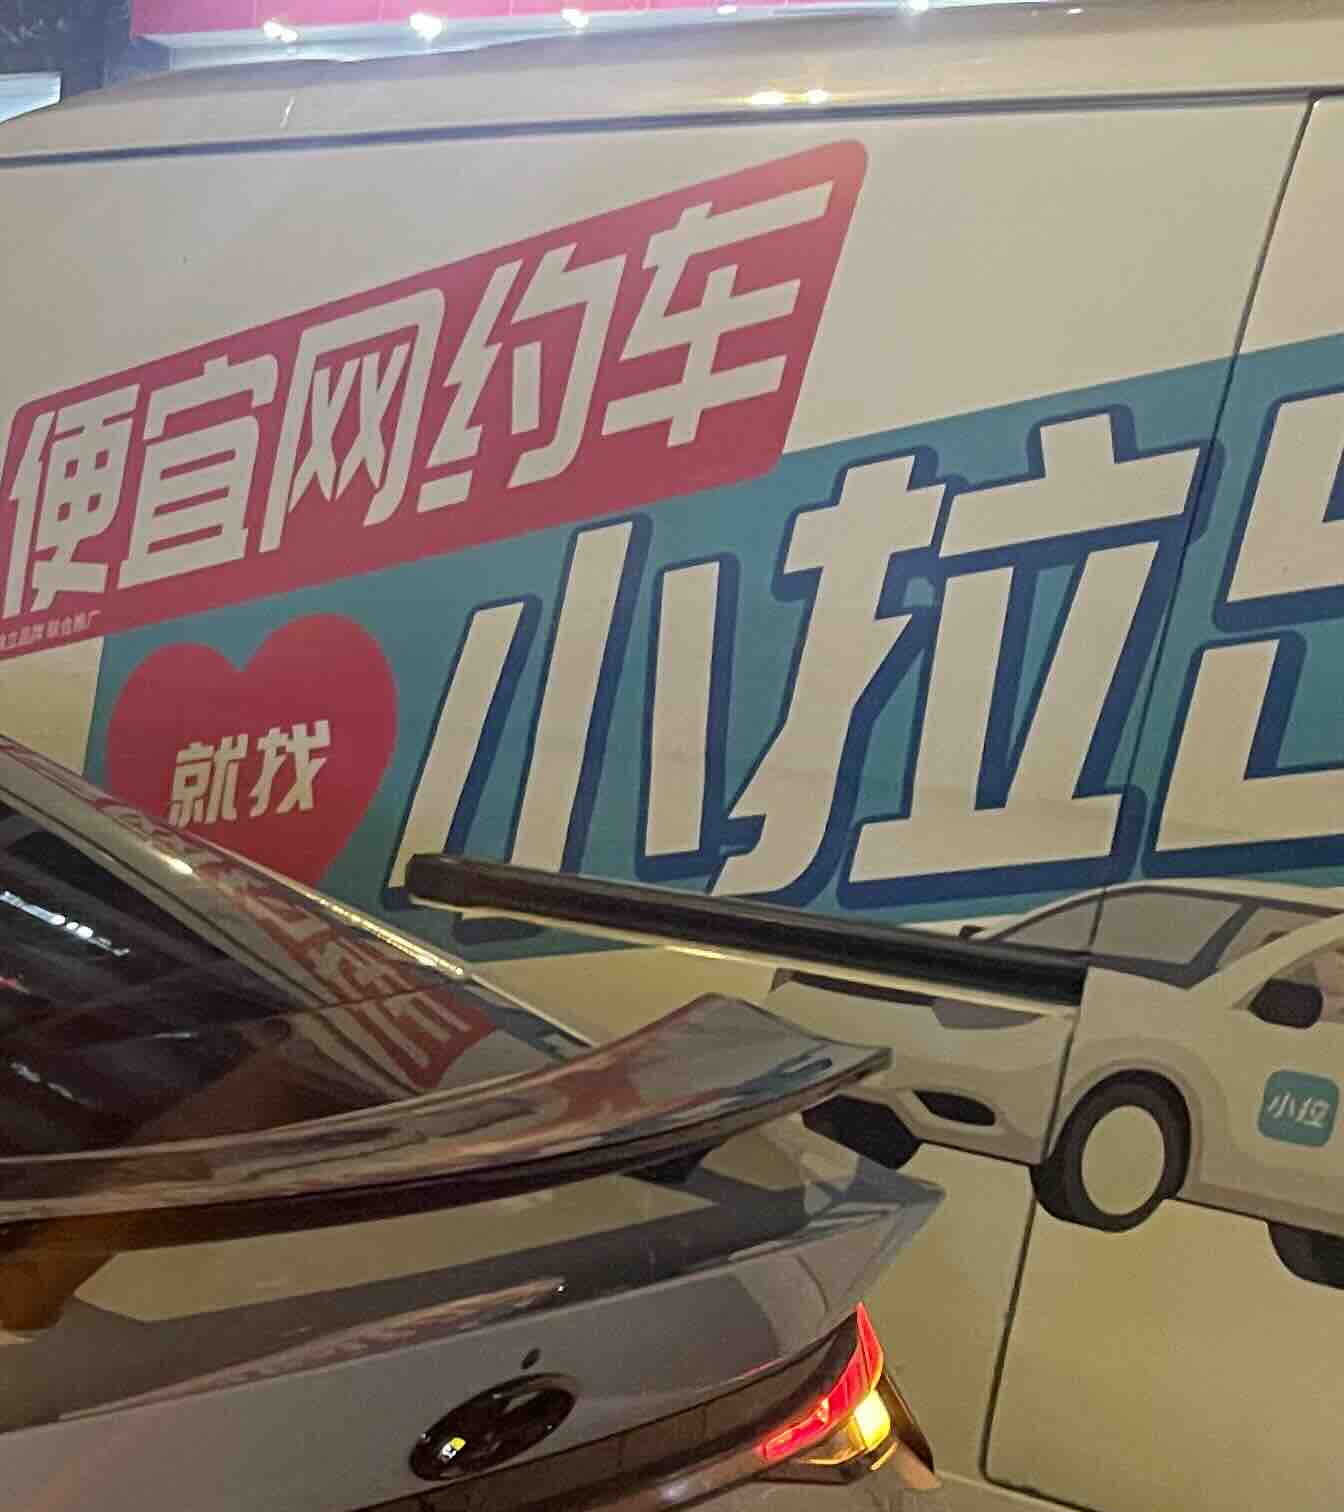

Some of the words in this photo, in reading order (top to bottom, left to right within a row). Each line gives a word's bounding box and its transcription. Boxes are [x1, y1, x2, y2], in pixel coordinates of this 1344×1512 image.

[2, 181, 833, 617] 便宜网约车
[168, 720, 331, 829] 就找
